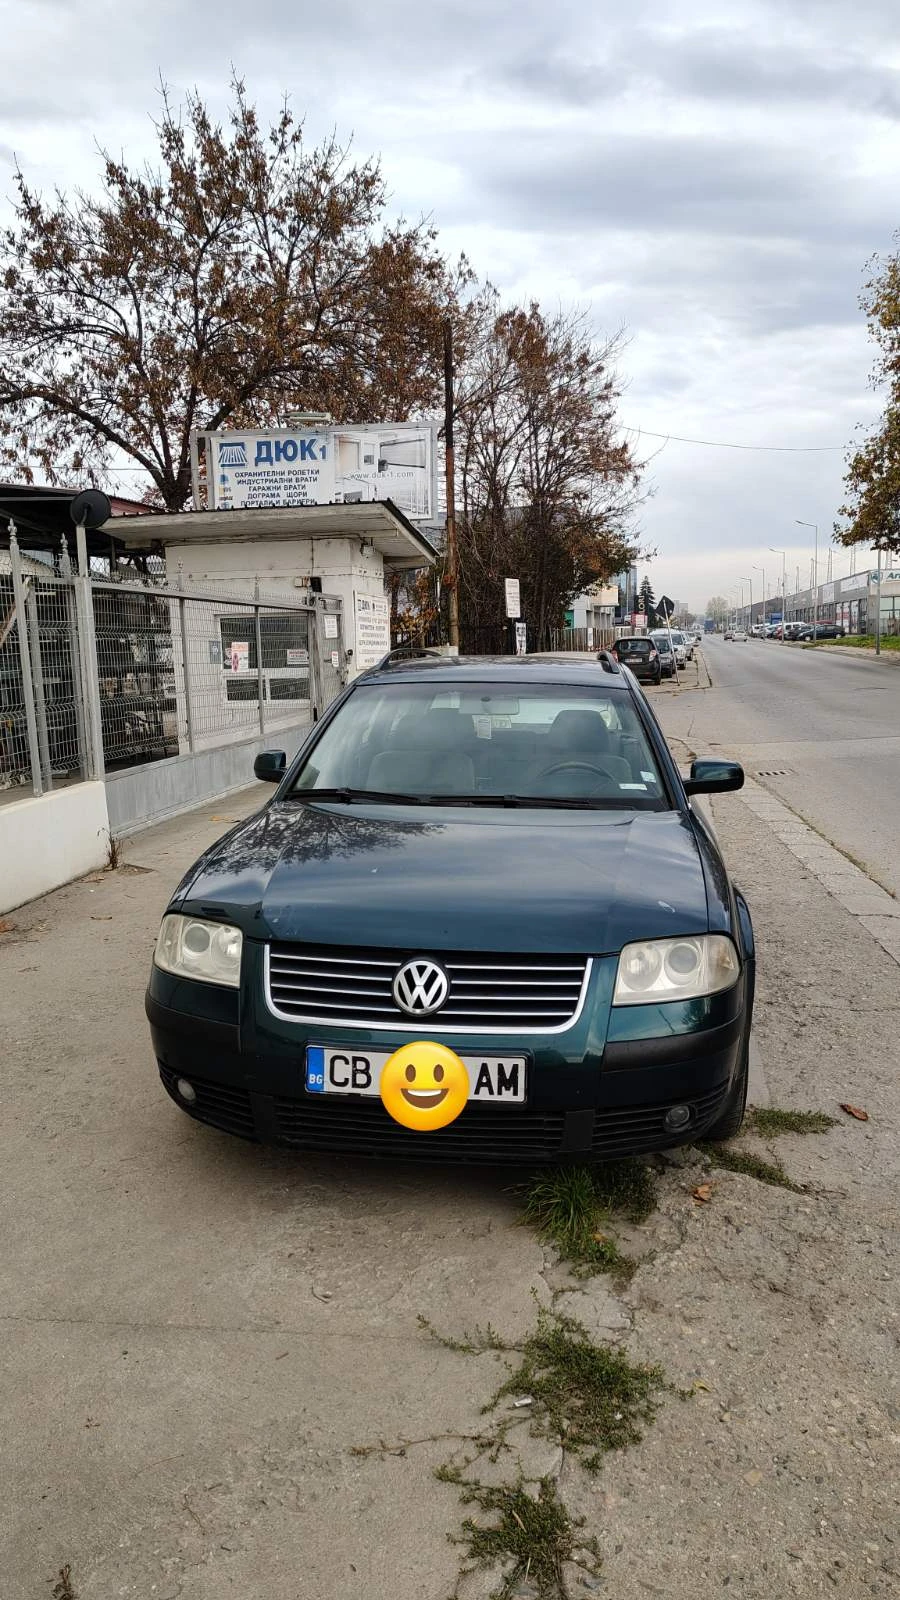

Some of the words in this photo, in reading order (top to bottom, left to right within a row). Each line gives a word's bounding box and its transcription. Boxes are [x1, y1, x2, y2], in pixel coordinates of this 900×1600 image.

[235, 470, 286, 478] ОХРАНИТЕЛНИ
[237, 477, 293, 485] ИНДУСТРИАЛНИ
[308, 1074, 323, 1085] BG
[474, 1062, 519, 1097] AM
